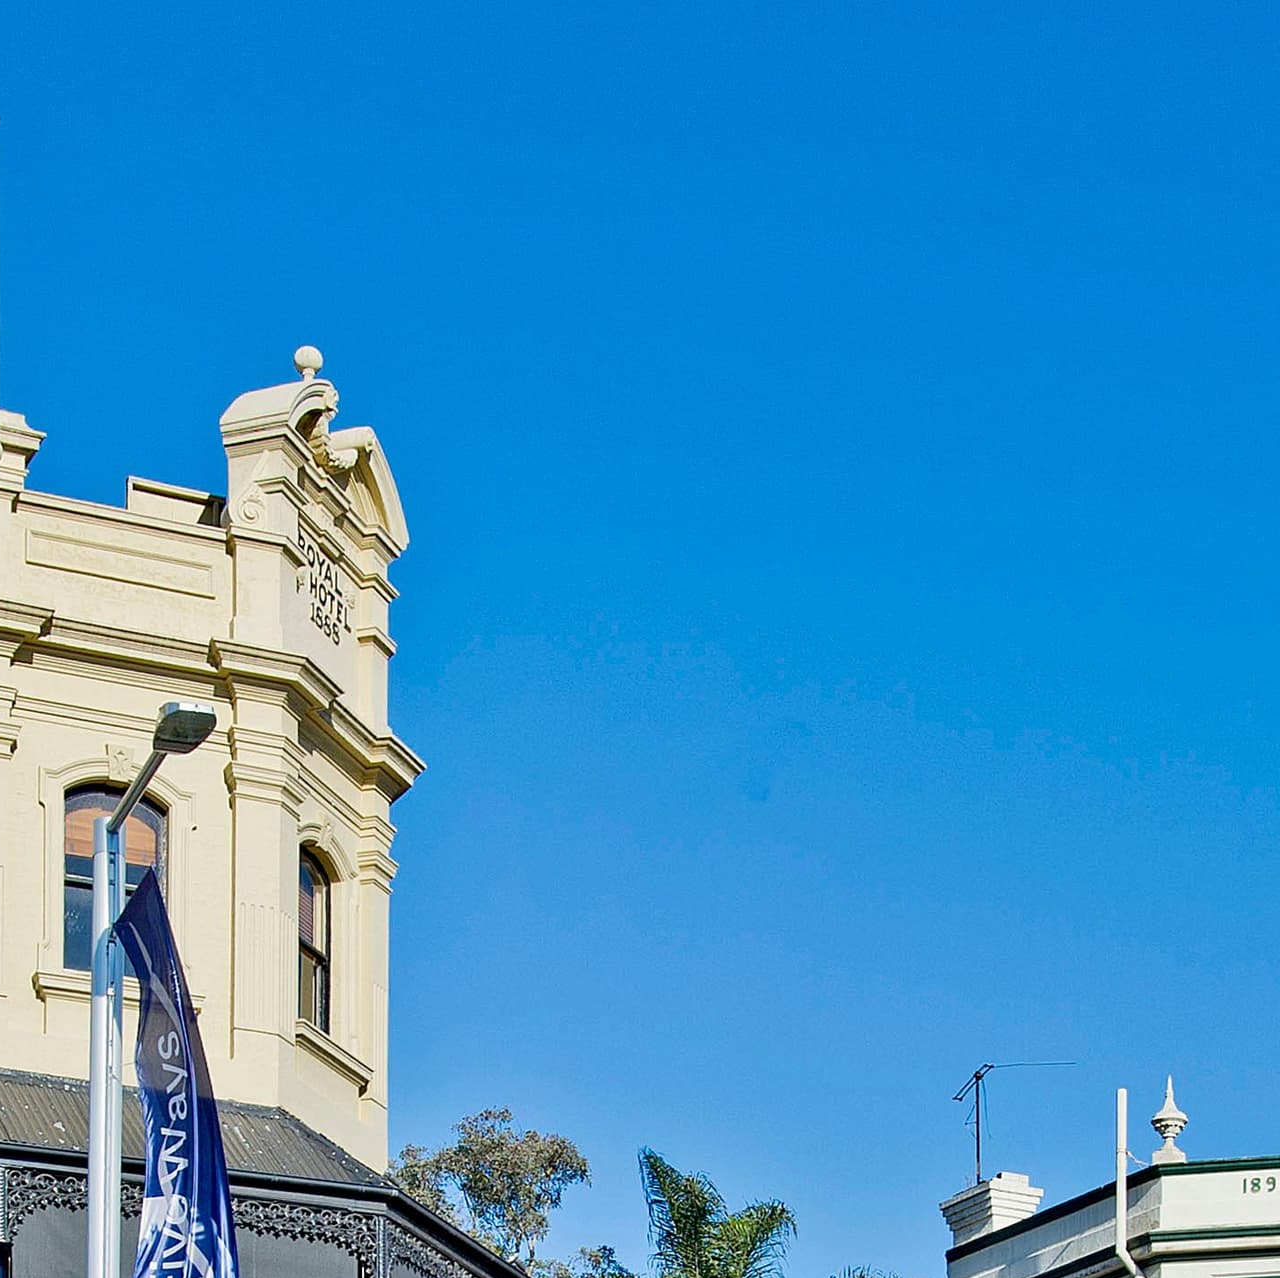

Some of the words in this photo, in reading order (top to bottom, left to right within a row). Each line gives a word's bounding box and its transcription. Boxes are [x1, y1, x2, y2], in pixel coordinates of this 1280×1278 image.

[310, 571, 351, 633] HOTEL
[310, 602, 340, 645] 1888
[158, 1031, 188, 1198] Ways
